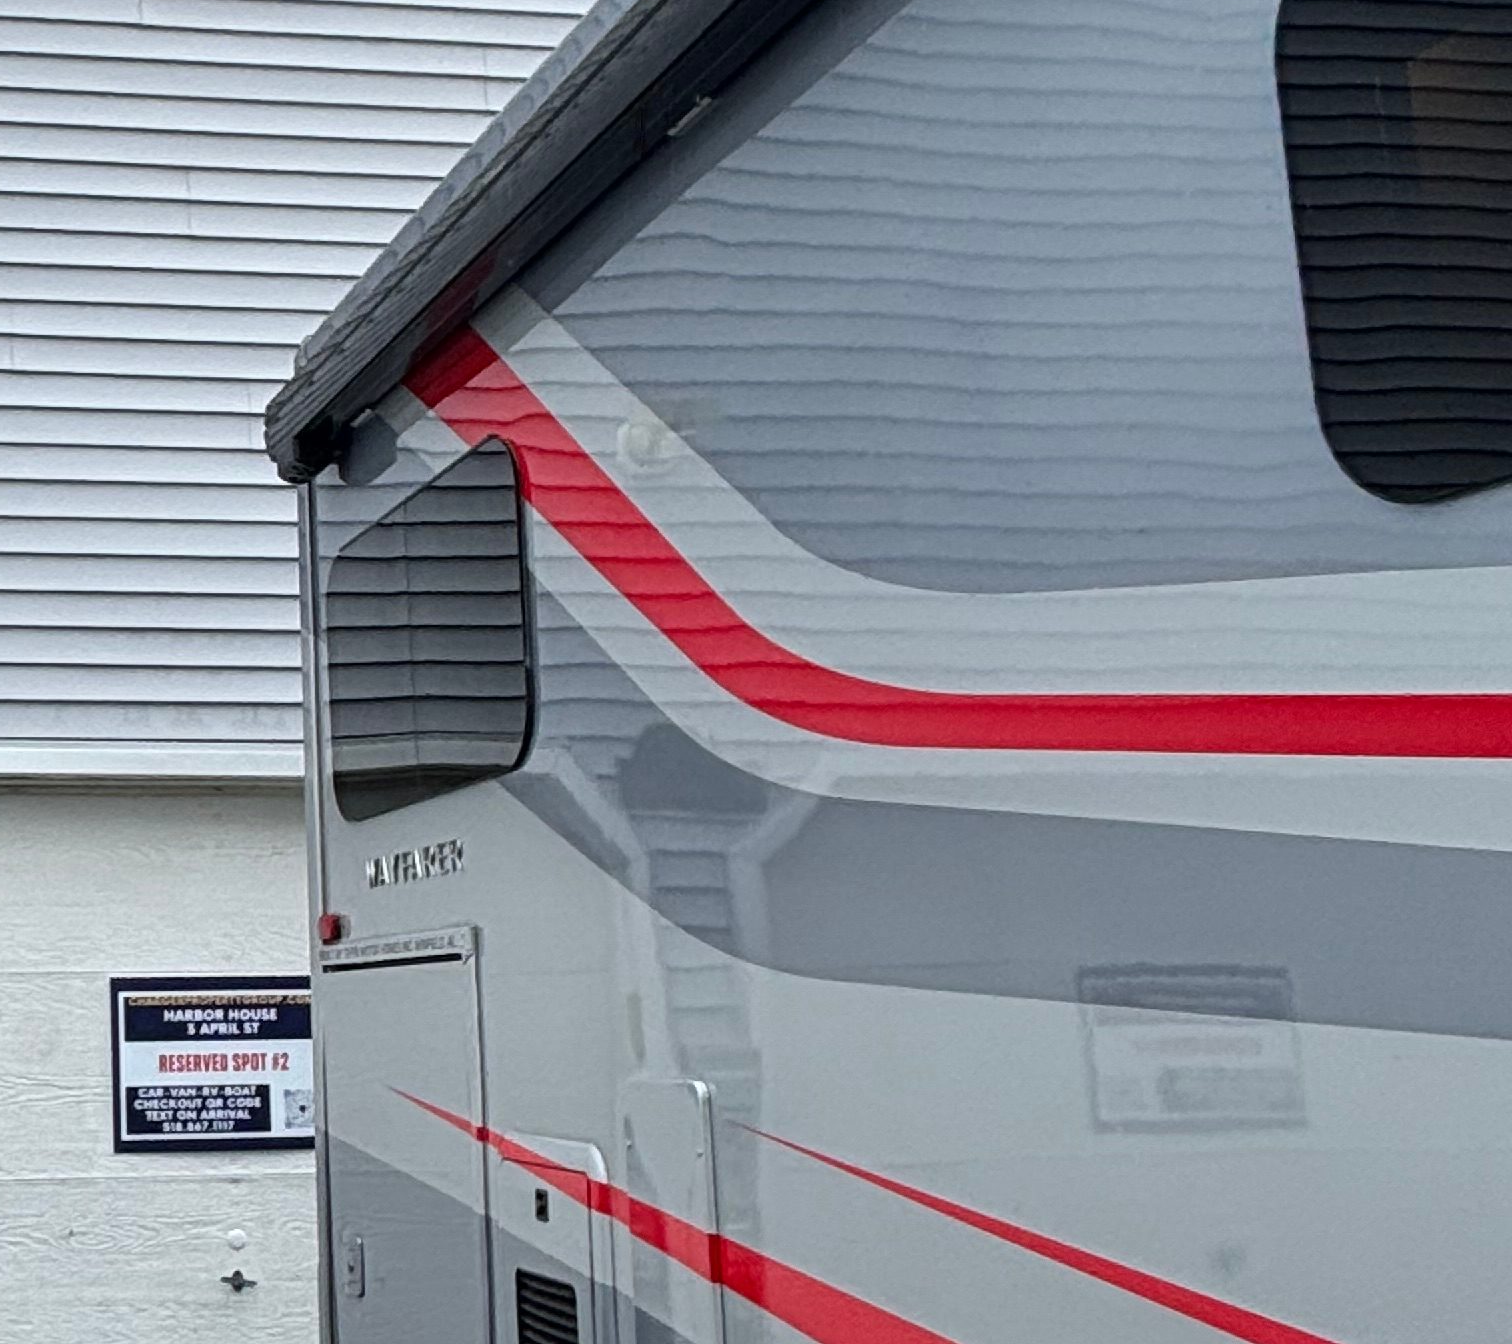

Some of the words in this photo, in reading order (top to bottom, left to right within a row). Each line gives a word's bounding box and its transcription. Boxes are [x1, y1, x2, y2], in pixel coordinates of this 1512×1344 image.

[365, 837, 465, 889] WAYFARER
[163, 1009, 223, 1021] HARBOR
[228, 1008, 277, 1020] HOUSE
[200, 1023, 240, 1035] APRIL
[243, 1022, 261, 1034] ST
[158, 1054, 228, 1073] RESERVED
[232, 1053, 268, 1072] SPOT
[271, 1052, 290, 1071] #2
[134, 1098, 202, 1110] CHECKOUT
[227, 1097, 262, 1108] CODE
[145, 1111, 174, 1121] TEXT
[176, 1110, 197, 1120] ON
[200, 1110, 251, 1120] ARRIVAL
